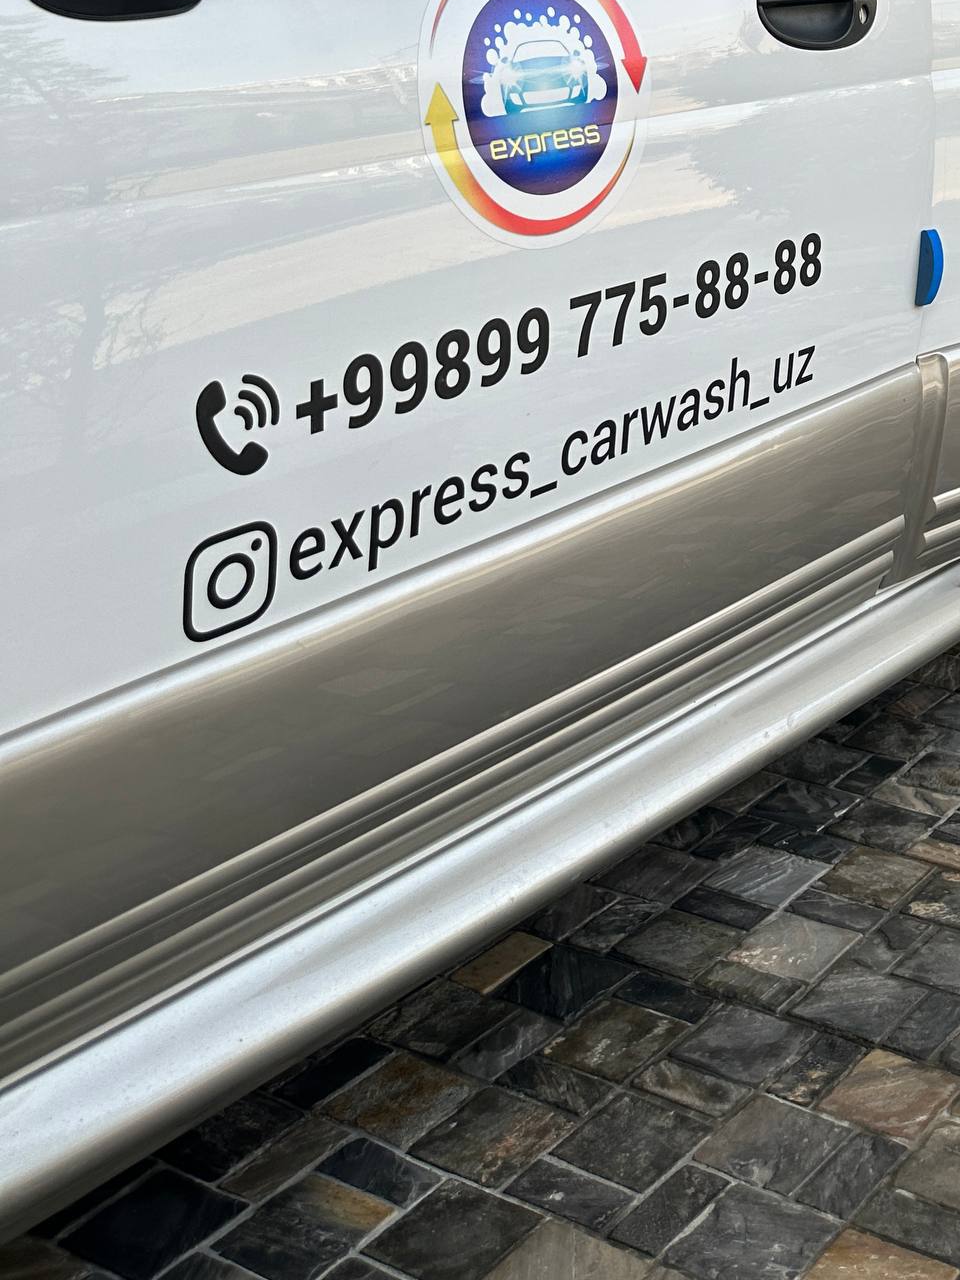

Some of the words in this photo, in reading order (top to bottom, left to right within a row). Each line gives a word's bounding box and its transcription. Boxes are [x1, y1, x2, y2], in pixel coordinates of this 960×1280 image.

[489, 124, 600, 162] express
[295, 307, 550, 435] +99899
[569, 232, 822, 358] 775-88-88
[289, 345, 816, 581] express_carwash_uz
